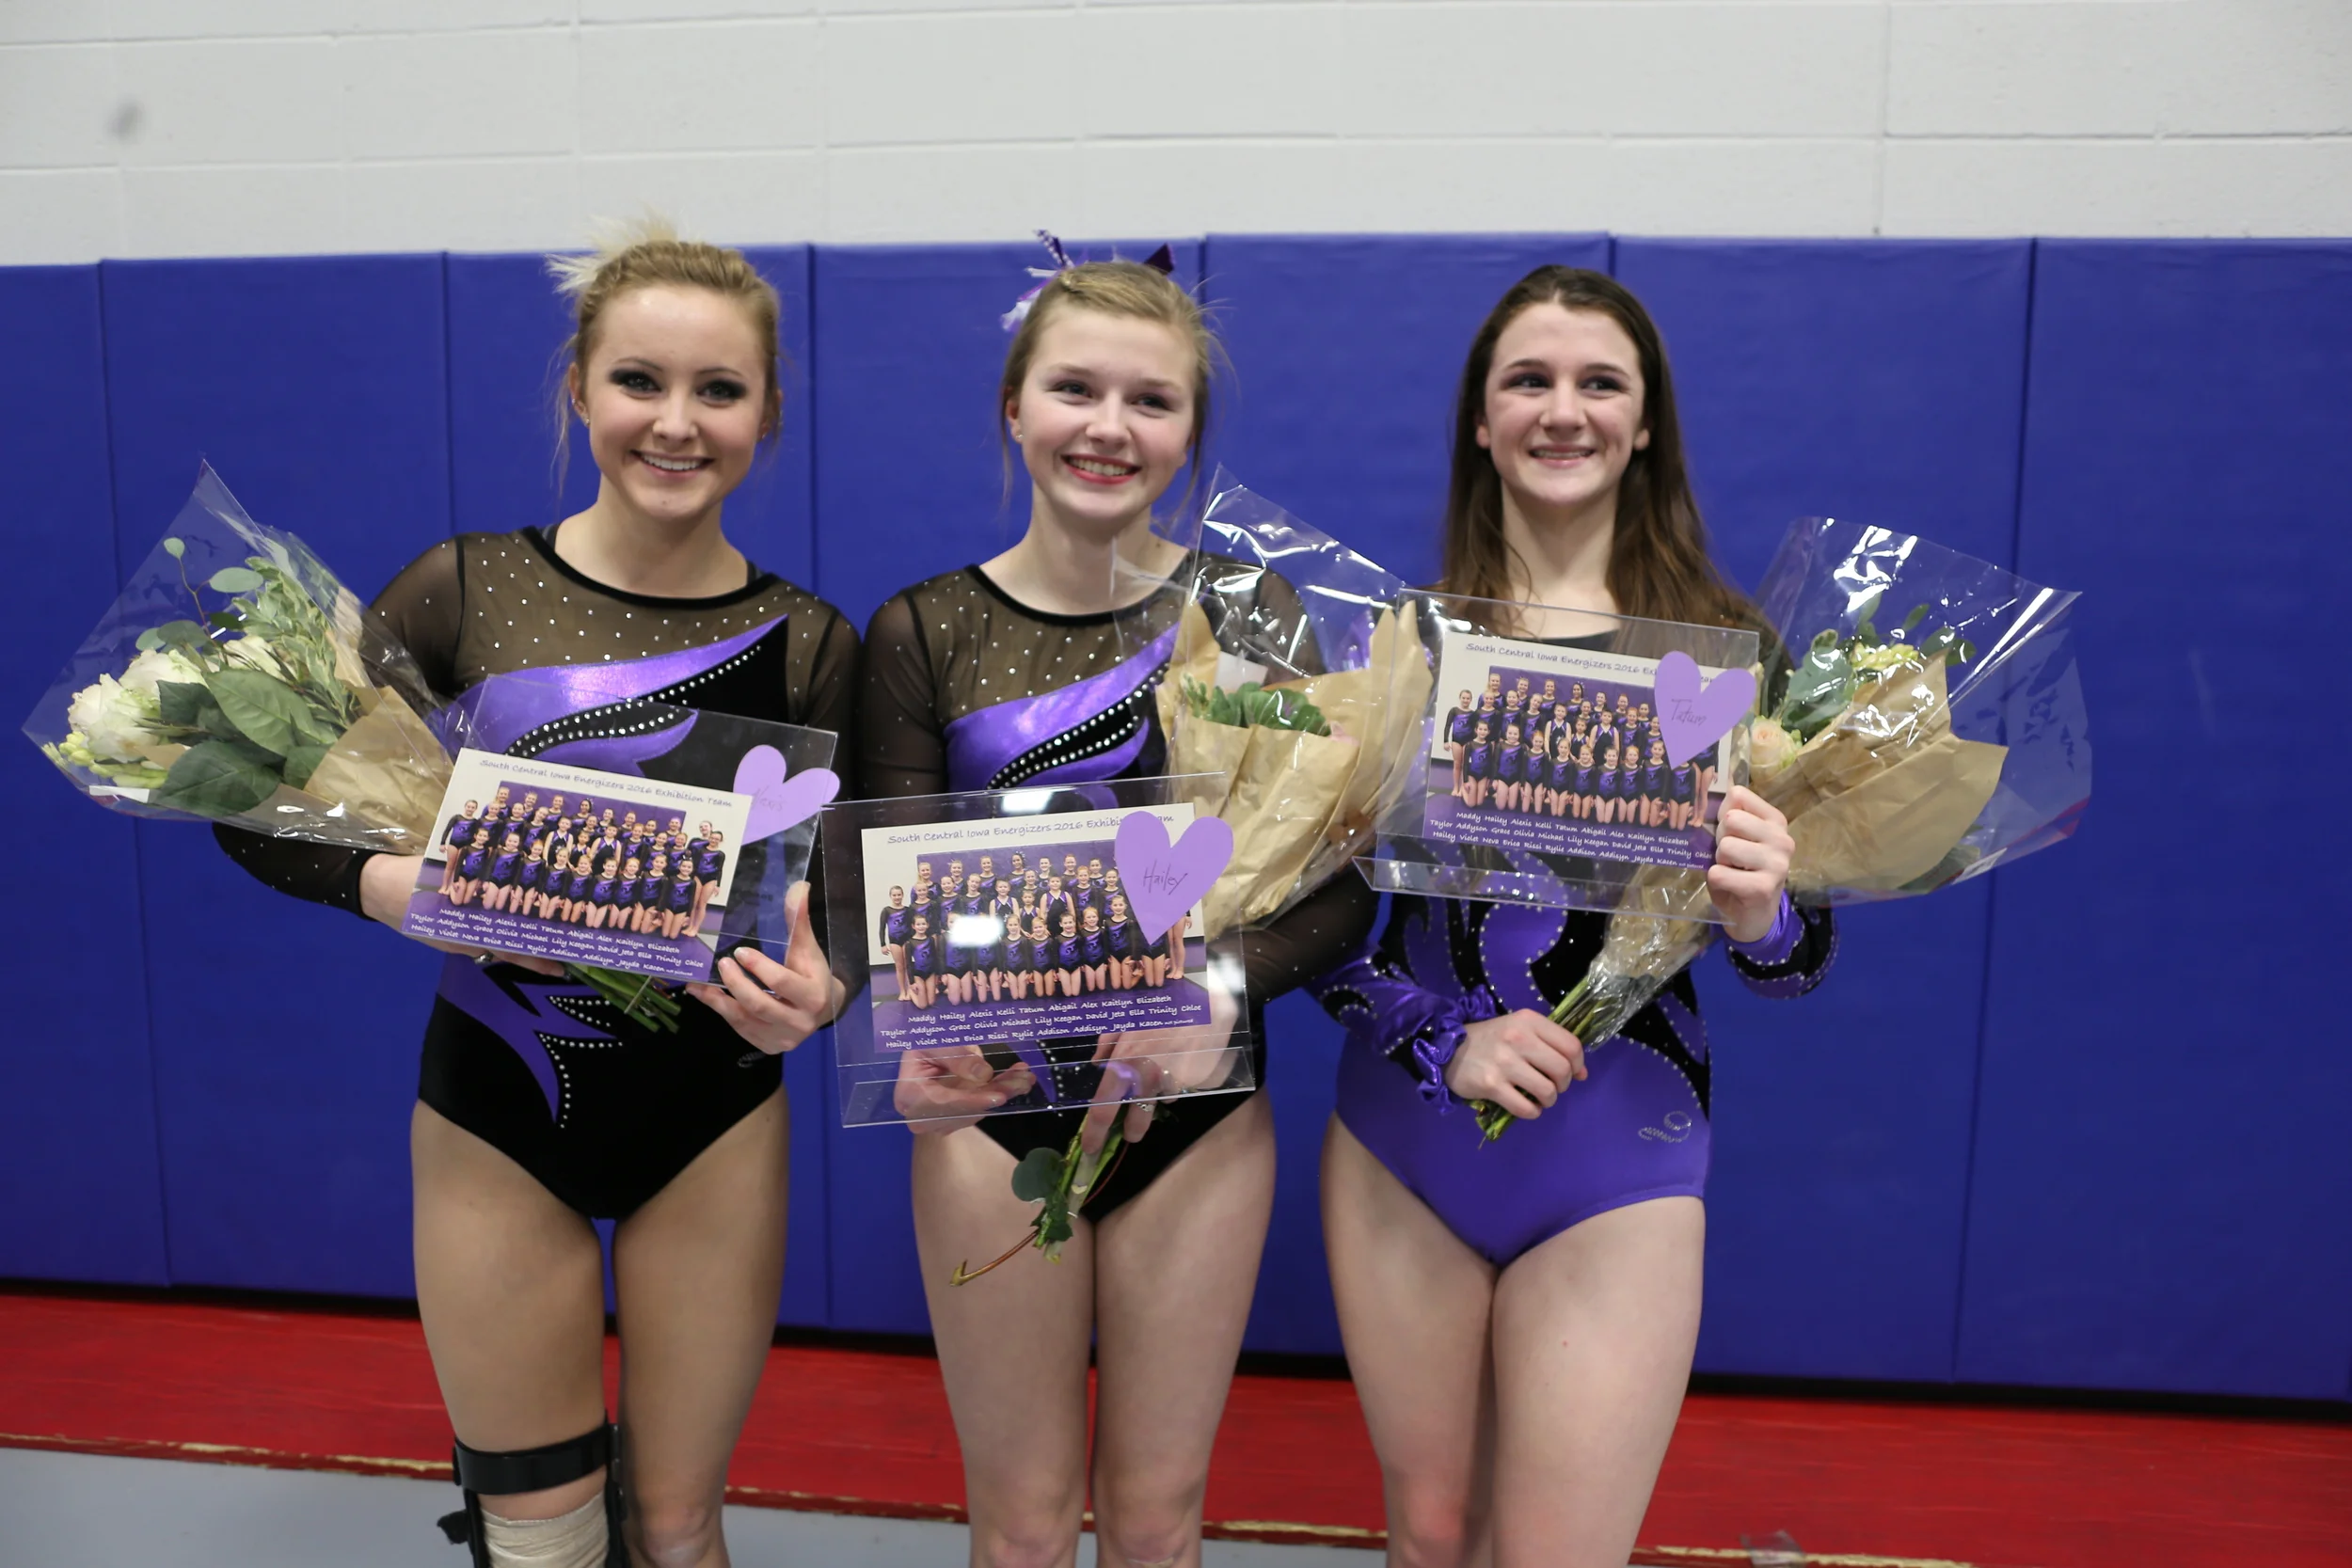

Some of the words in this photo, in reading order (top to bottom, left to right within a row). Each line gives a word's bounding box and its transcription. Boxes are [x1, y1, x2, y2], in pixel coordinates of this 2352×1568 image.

[1467, 642, 1496, 654] South
[1499, 647, 1534, 659] Central
[1538, 653, 1559, 663] Iowa
[1562, 656, 1613, 671] Energizers
[1614, 663, 1640, 674] 2016
[1671, 698, 1708, 727] Tatum
[480, 761, 510, 771] South
[513, 766, 548, 777] Central
[550, 771, 571, 781] Iowa
[574, 775, 625, 790] Energizers
[628, 784, 653, 795] 2016
[656, 788, 705, 803] Exhibition
[708, 797, 733, 808] Team
[888, 832, 921, 845] South
[924, 830, 964, 842] Central
[967, 829, 991, 838] Iowa
[994, 824, 1052, 837] Energizers
[1055, 821, 1084, 832] 2016
[1087, 817, 1123, 829] Exhibi
[1430, 819, 1454, 830] Taylor
[1456, 823, 1488, 833] Addyson
[1491, 828, 1511, 836] Grace
[1514, 830, 1535, 838] Olivia
[1538, 832, 1565, 842] Michael
[1568, 835, 1583, 847] Lily
[1584, 839, 1610, 847] Keegan
[1613, 842, 1632, 850] David
[1667, 847, 1692, 859] Trinity
[1456, 813, 1482, 823] Maddy
[1486, 816, 1508, 827] Hailey
[1511, 819, 1533, 828] Alexis
[1556, 824, 1579, 832] Tatum
[1581, 828, 1607, 836] Abigail
[1629, 833, 1656, 844] Kaitlyn
[1659, 836, 1690, 847] Elizabeth
[1434, 832, 1456, 842] Hailey
[1460, 834, 1479, 843] Violet
[1503, 839, 1521, 847] Erica
[1546, 845, 1565, 854] Rylie
[1567, 847, 1597, 857] Addison
[1631, 855, 1655, 864] Jayda
[1143, 859, 1188, 895] Hailey
[411, 913, 436, 924] Taylor
[437, 919, 470, 929] Addyson
[473, 926, 494, 934] Grace
[497, 929, 519, 938] Olivia
[521, 933, 548, 943] Michael
[552, 938, 568, 948] Lily
[569, 942, 596, 950] Keegan
[598, 945, 619, 954] David
[656, 955, 683, 966] Trinity
[685, 960, 705, 969] Chloe
[411, 925, 436, 937] Hailey
[439, 929, 459, 939] Violet
[484, 937, 502, 945] Erica
[528, 944, 548, 954] Rylie
[549, 949, 580, 958] Addison
[616, 959, 641, 969] Jayda
[439, 909, 466, 921] Maddy
[469, 914, 493, 926] Hailey
[495, 919, 517, 927] Alexis
[520, 923, 538, 931] Kelli
[542, 927, 564, 936] Tatum
[567, 931, 595, 940] Abigail
[616, 939, 645, 949] Kaitlyn
[648, 943, 680, 954] Elizabeth
[881, 1029, 908, 1038] Taylor
[910, 1026, 946, 1036] Addyson
[975, 1021, 999, 1030] Olivia
[1002, 1019, 1032, 1027] Michael
[1035, 1017, 1053, 1026] Lily
[1086, 1012, 1108, 1021] David
[1149, 1006, 1178, 1016] Trinity
[909, 1015, 937, 1024] Maddy
[940, 1012, 966, 1022] Hailey
[969, 1009, 993, 1019] Alexis
[997, 1007, 1016, 1016] Kelli
[1048, 1003, 1078, 1012] Abigail
[1102, 999, 1134, 1008] Kaitlyn
[1136, 996, 1172, 1005] Elizabeth
[886, 1040, 913, 1049] Hailey
[964, 1034, 985, 1042] Erica
[1012, 1030, 1035, 1038] Rylie
[1037, 1027, 1071, 1037] Addison
[1110, 1022, 1136, 1032] Jayda
